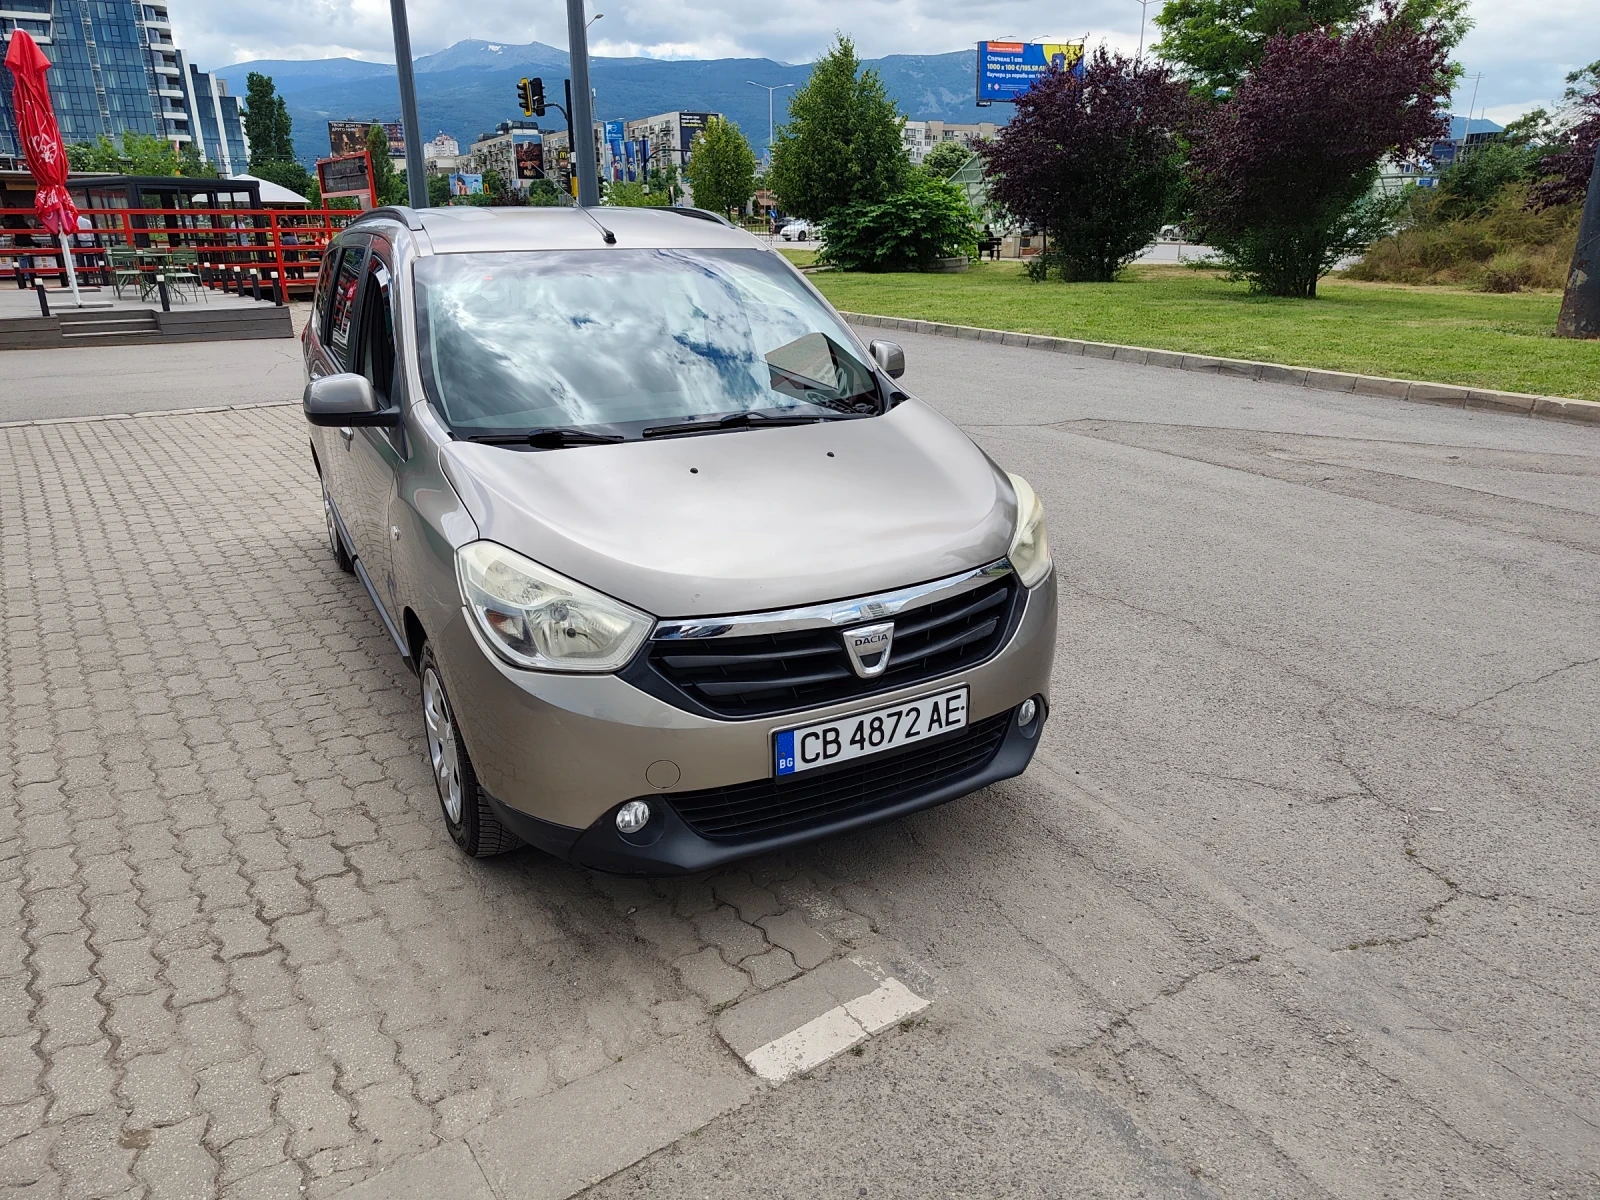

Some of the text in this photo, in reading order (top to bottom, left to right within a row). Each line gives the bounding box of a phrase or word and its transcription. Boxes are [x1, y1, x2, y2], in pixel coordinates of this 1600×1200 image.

[854, 633, 889, 647] DACIA
[800, 694, 962, 764] CB 4872 AE
[779, 757, 794, 769] BG
